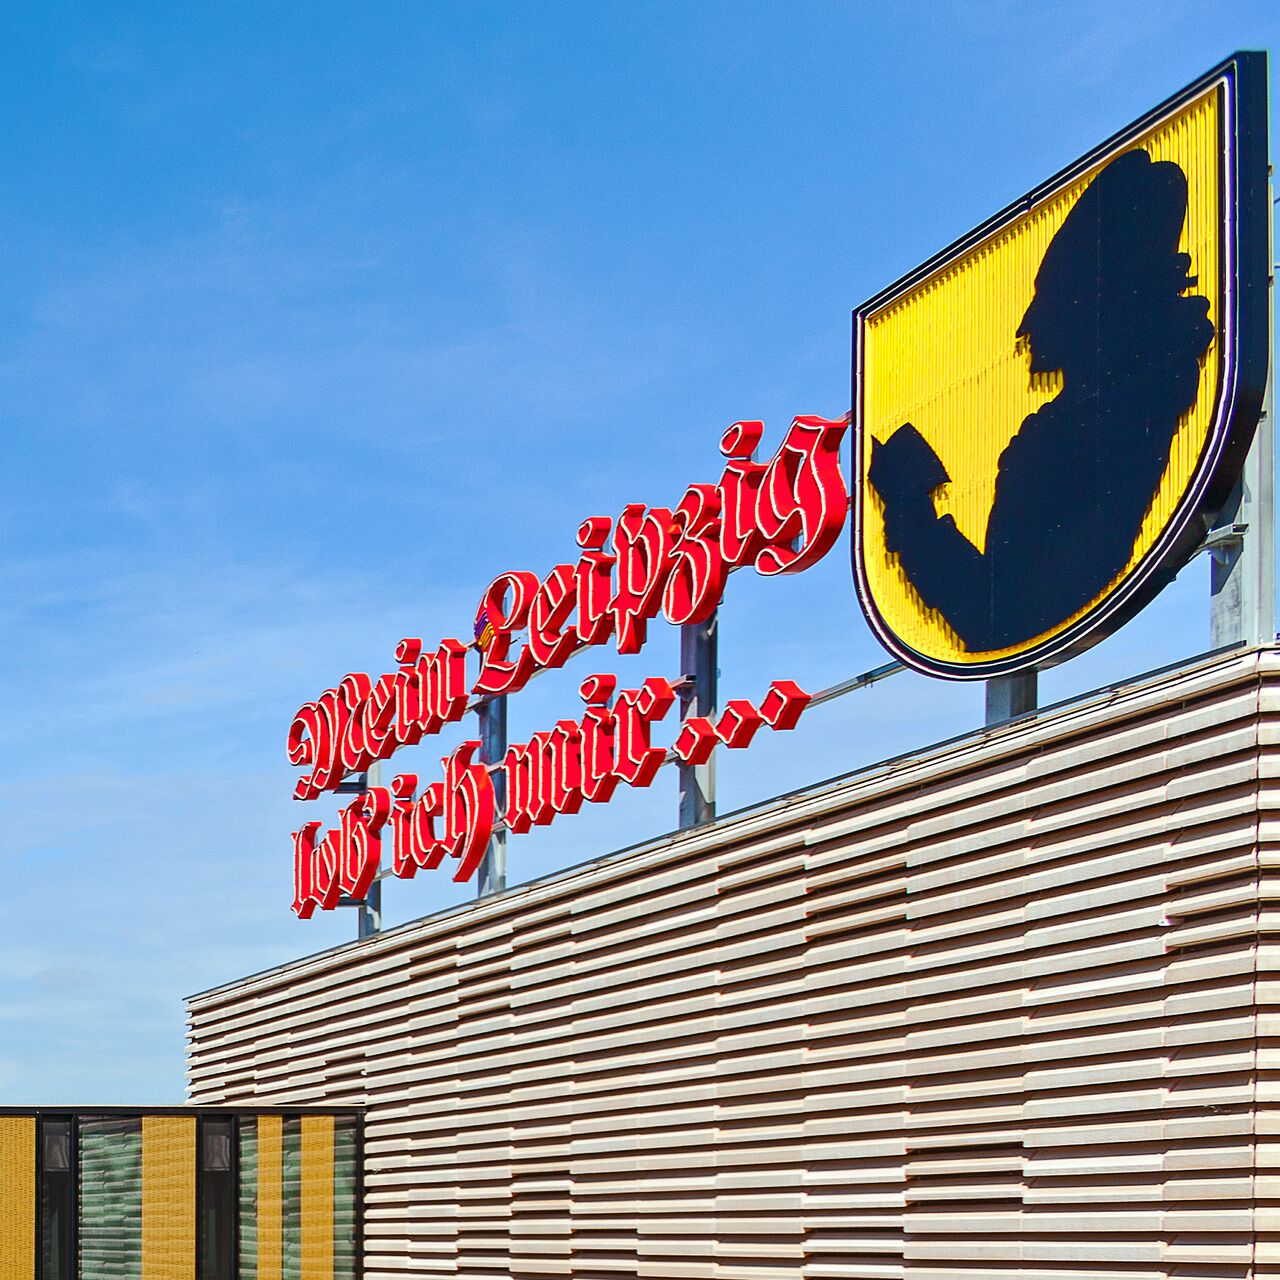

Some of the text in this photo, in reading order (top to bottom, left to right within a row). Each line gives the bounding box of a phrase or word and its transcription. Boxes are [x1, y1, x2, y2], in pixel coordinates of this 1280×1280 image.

[288, 415, 848, 800] Mein Leipzig
[389, 741, 495, 882] ich
